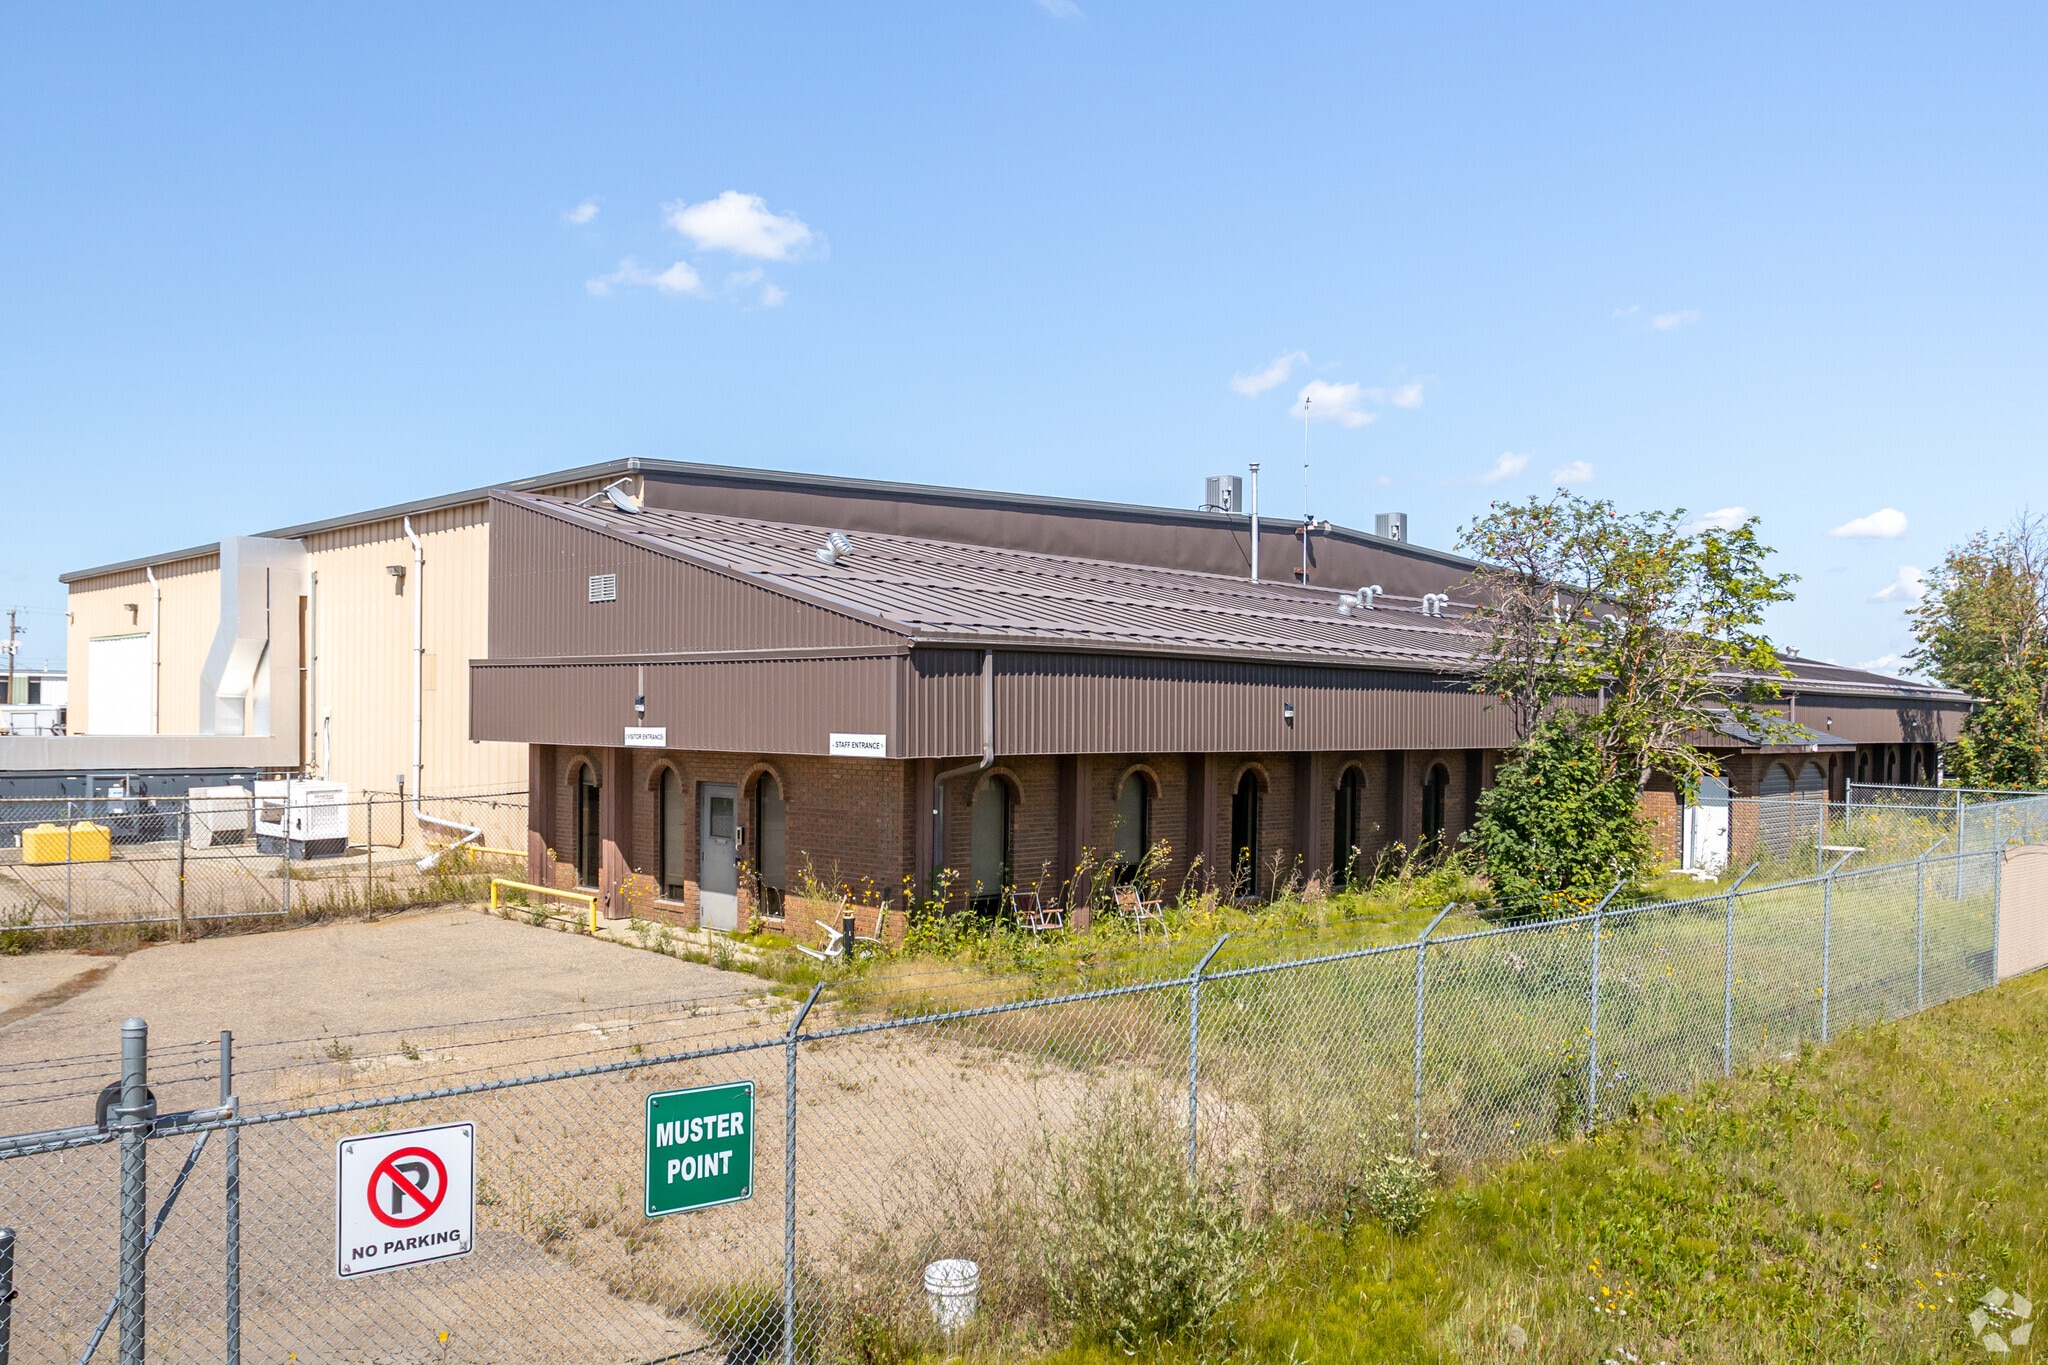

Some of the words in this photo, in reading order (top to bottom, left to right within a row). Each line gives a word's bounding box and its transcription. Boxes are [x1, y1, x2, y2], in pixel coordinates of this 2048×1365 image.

[835, 741, 851, 749] STAFF
[851, 741, 880, 750] ENTRANCE
[656, 1111, 744, 1148] MUSTER
[667, 1150, 733, 1184] POINT
[391, 1161, 430, 1215] P
[352, 1245, 378, 1260] NO
[384, 1229, 461, 1254] PARKING
